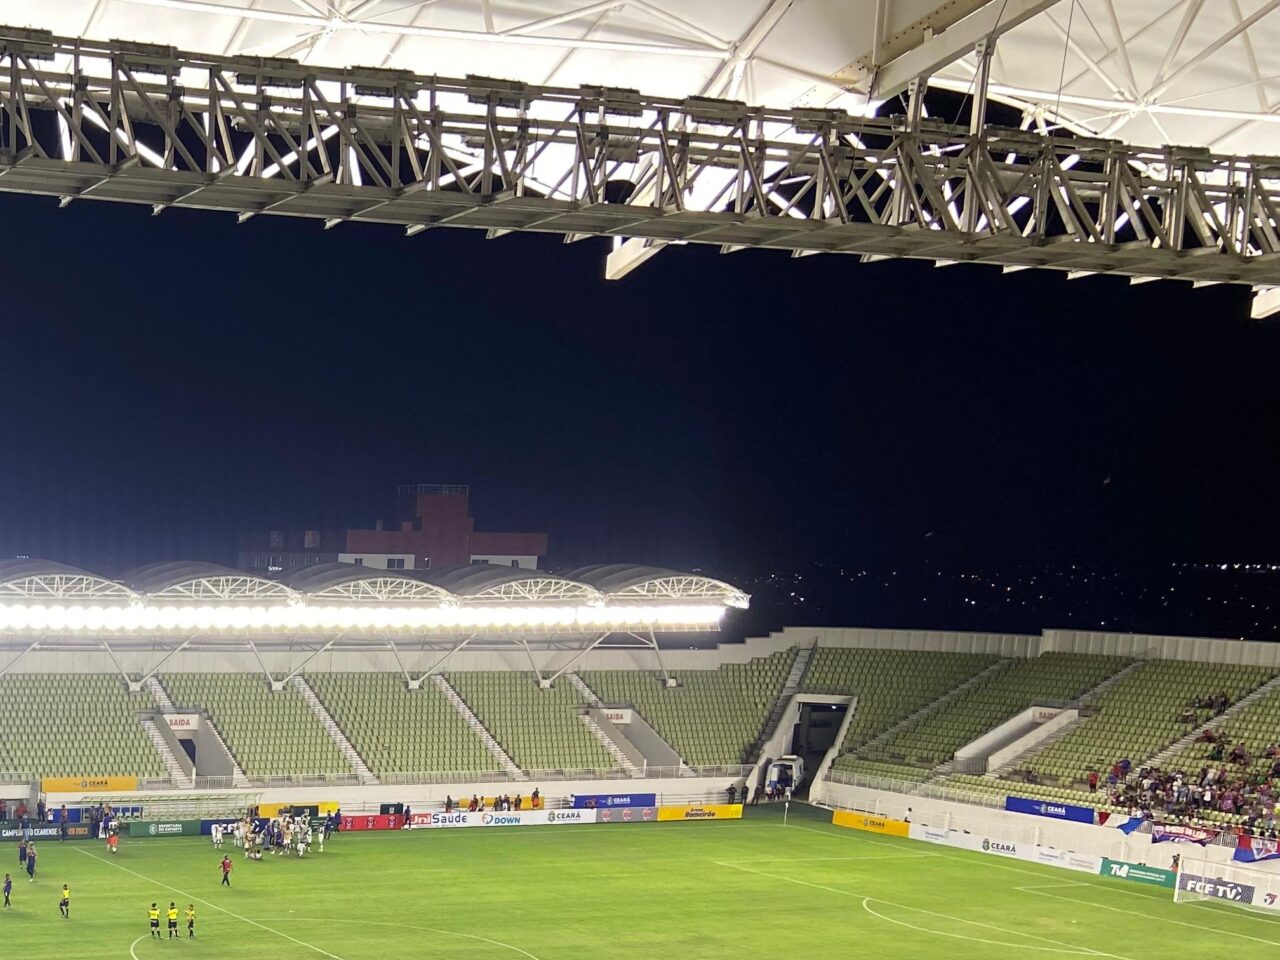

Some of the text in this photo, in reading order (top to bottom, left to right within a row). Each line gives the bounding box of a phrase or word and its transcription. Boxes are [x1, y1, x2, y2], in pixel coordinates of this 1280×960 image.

[556, 811, 581, 819] CEARÁ
[990, 842, 1016, 853] CEARÁ
[1186, 880, 1214, 894] FCF
